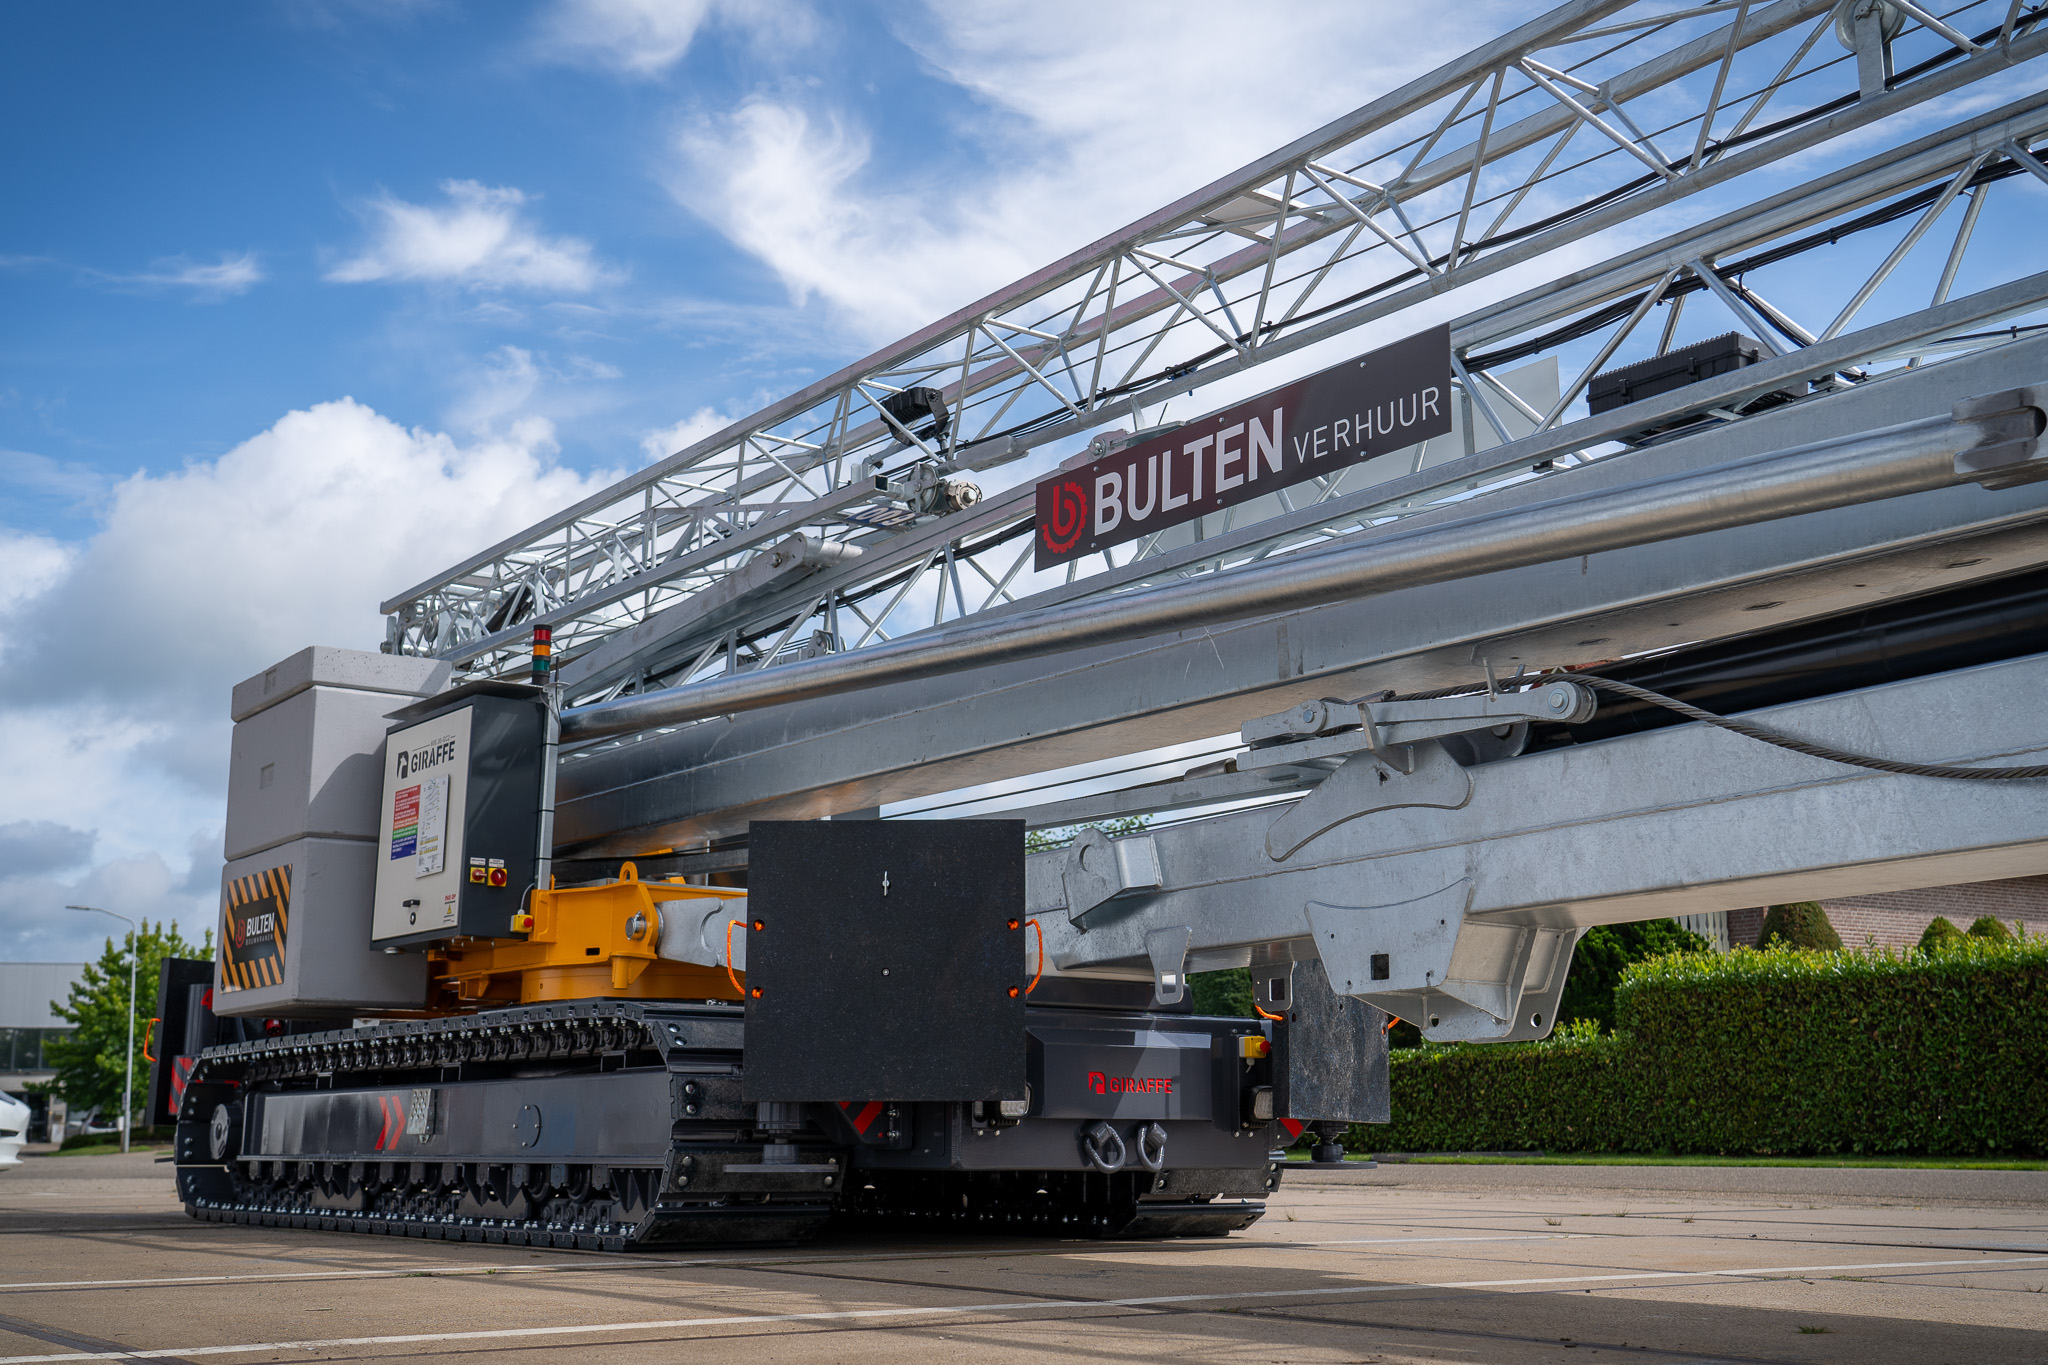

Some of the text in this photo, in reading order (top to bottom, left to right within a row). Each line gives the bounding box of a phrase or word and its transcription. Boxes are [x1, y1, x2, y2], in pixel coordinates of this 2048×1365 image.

[1093, 407, 1284, 537] BULTEN
[1293, 386, 1440, 464] VERHUUR
[411, 740, 456, 773] GIRAFFE
[246, 912, 275, 938] BULTEN
[1110, 1077, 1172, 1093] GIRAFFE
